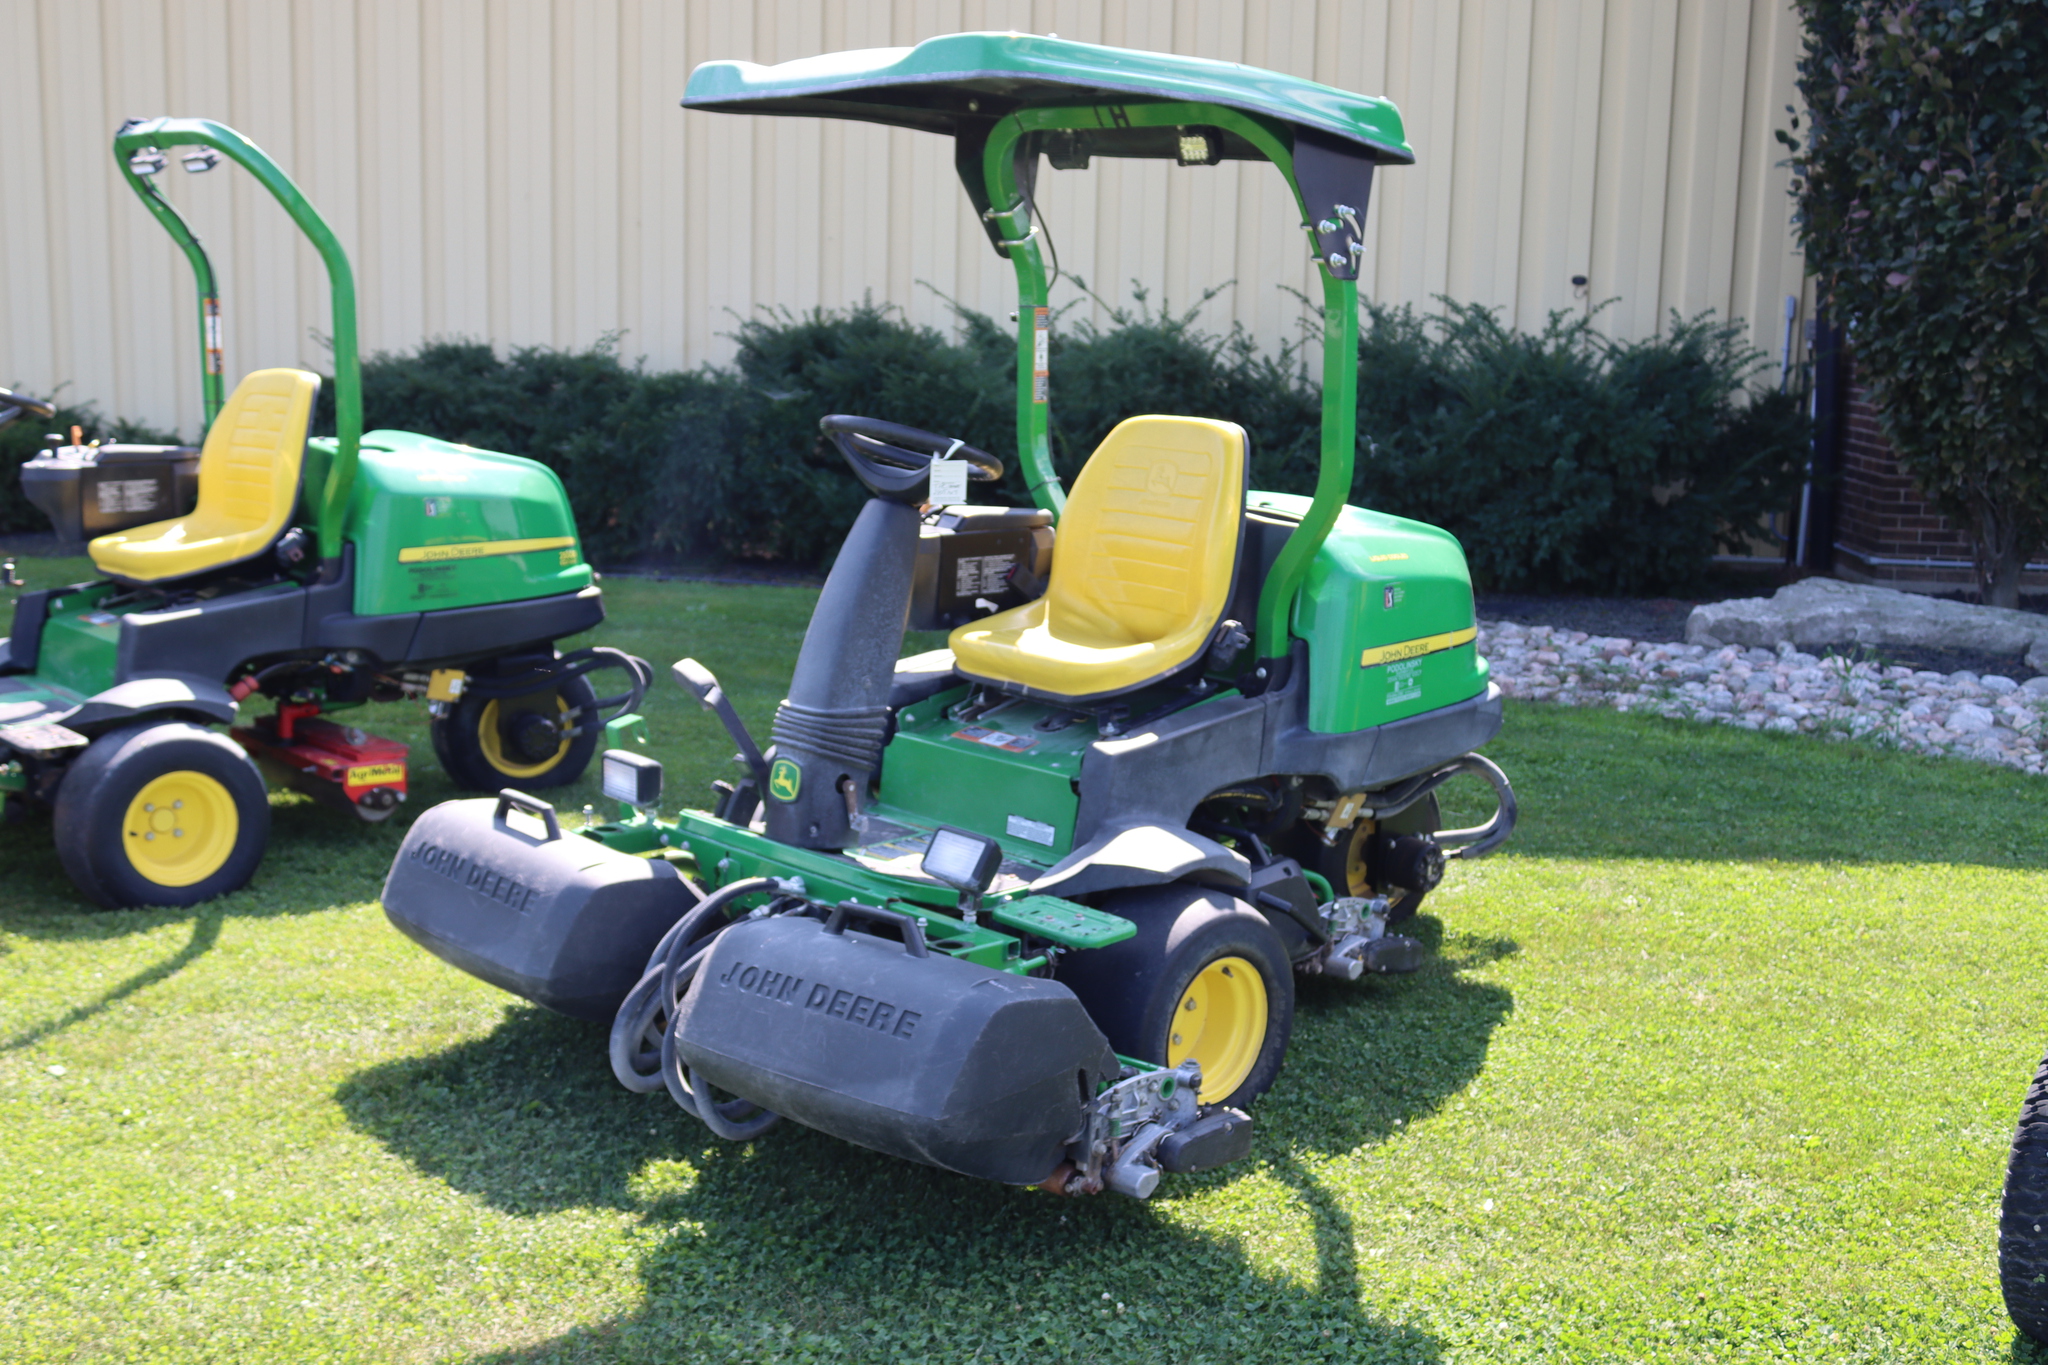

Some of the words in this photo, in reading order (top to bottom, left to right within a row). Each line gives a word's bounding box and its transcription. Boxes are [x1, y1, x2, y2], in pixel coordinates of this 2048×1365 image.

[422, 549, 449, 559] JOHN
[451, 546, 485, 557] DEERE
[1380, 648, 1402, 662] JOHN
[1404, 642, 1430, 656] DEERE
[409, 841, 467, 882] JOHN
[465, 863, 541, 916] DEERE
[719, 961, 804, 1006] JOHN
[804, 982, 923, 1041] DEERE
